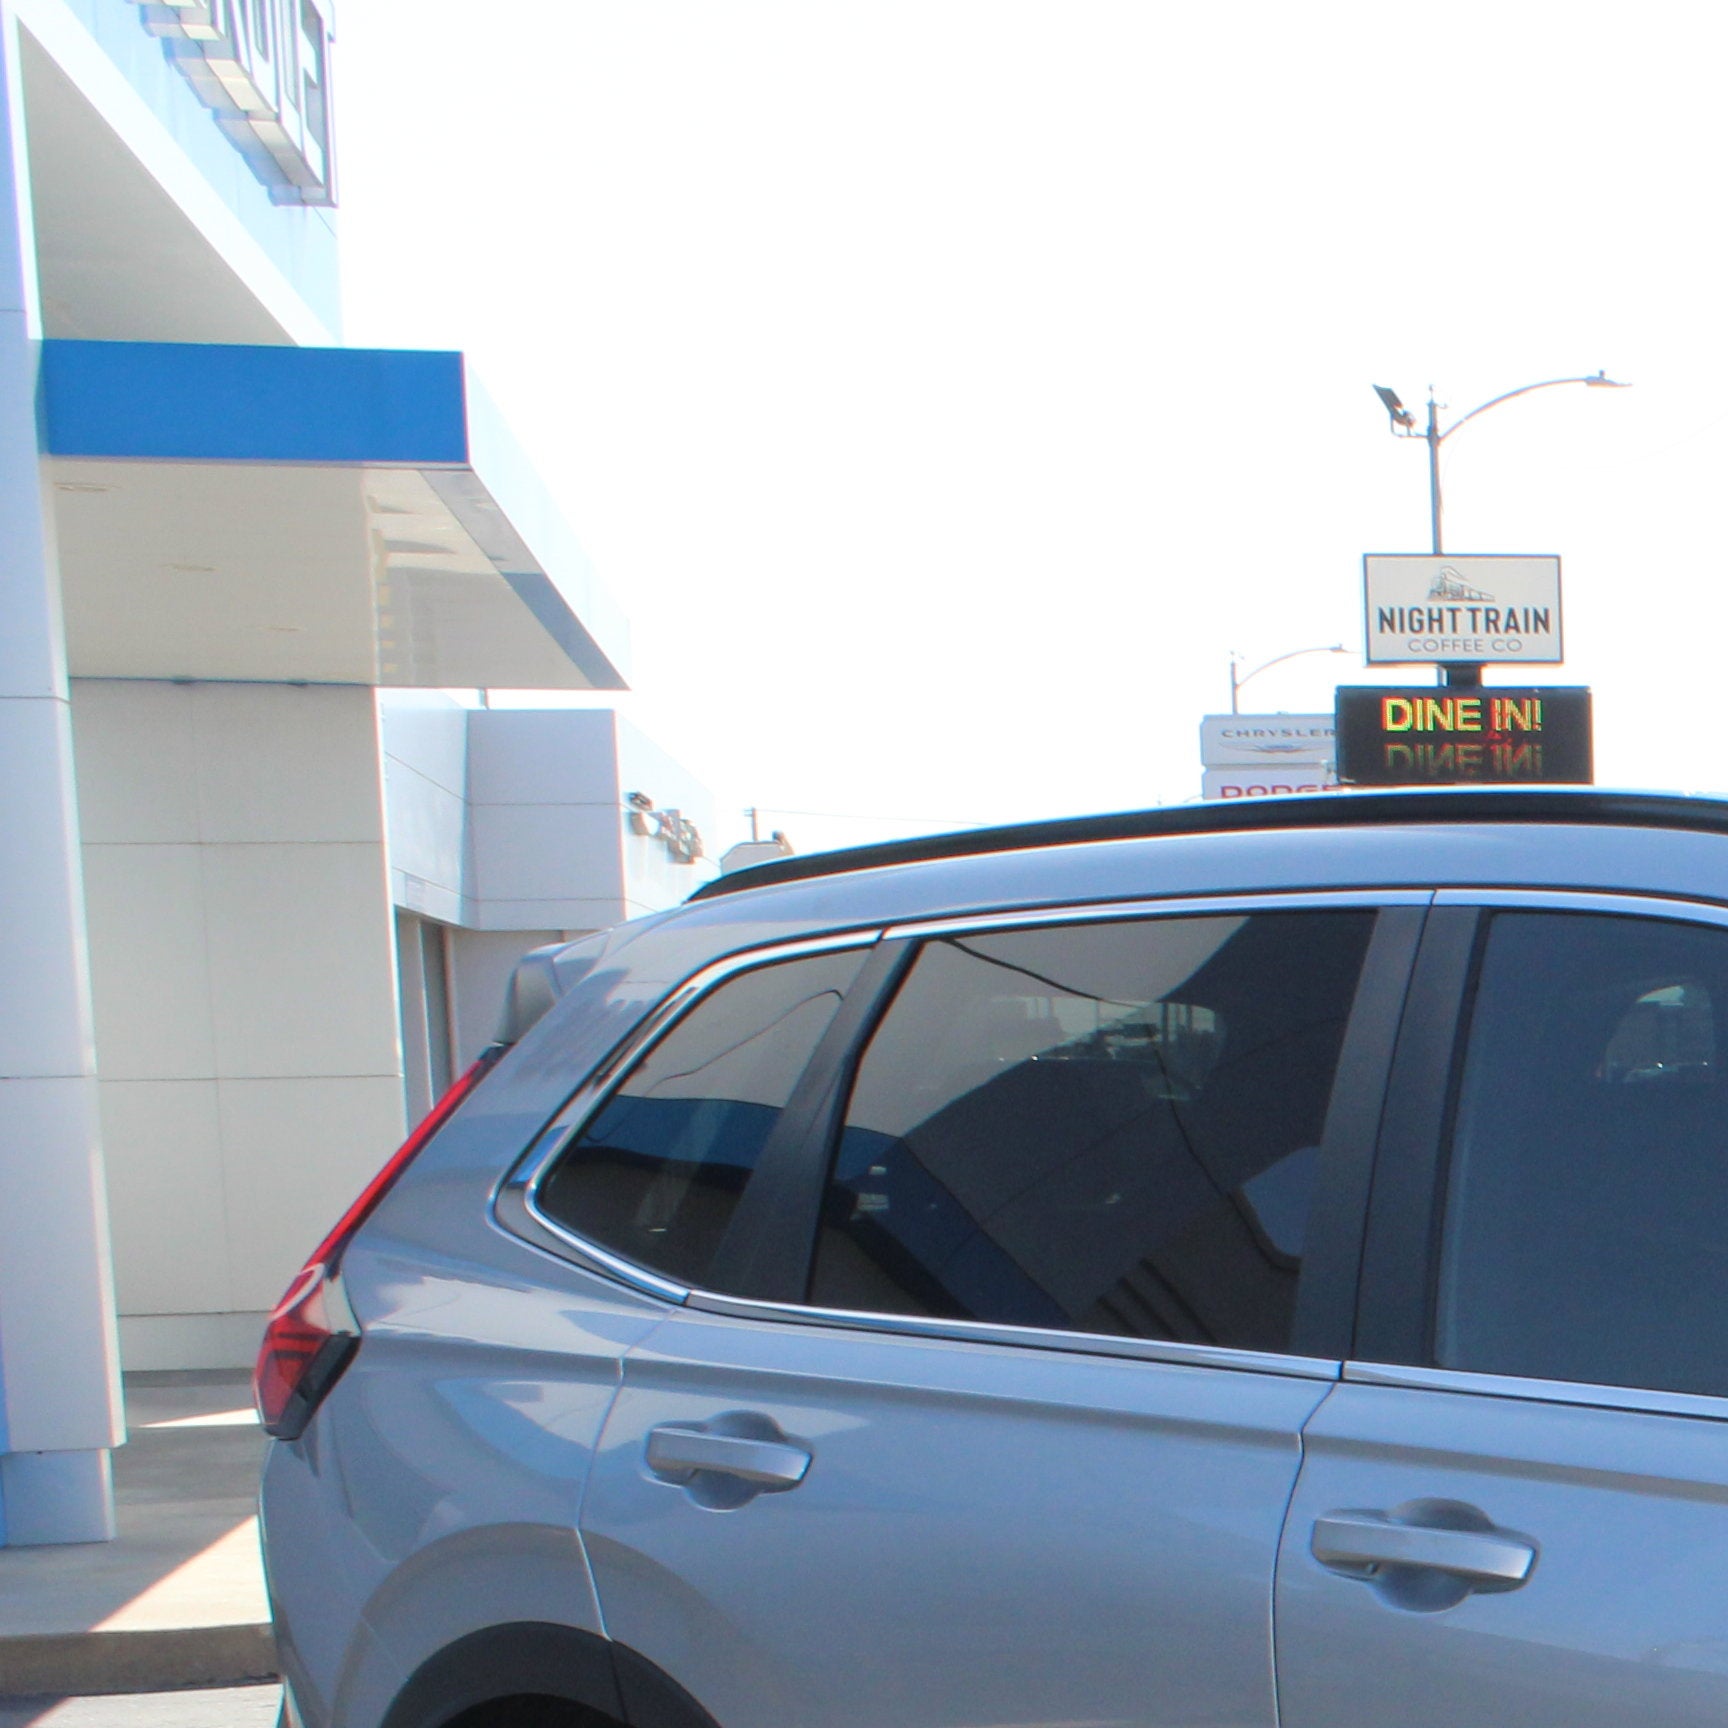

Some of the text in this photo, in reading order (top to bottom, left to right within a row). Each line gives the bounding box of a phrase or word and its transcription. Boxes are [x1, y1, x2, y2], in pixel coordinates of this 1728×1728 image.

[1378, 606, 1551, 635] NIGHT TRAIN
[1407, 638, 1523, 653] COFFEE CO
[1381, 696, 1543, 732] DINE IN!
[1221, 728, 1336, 739] CHRYSLER
